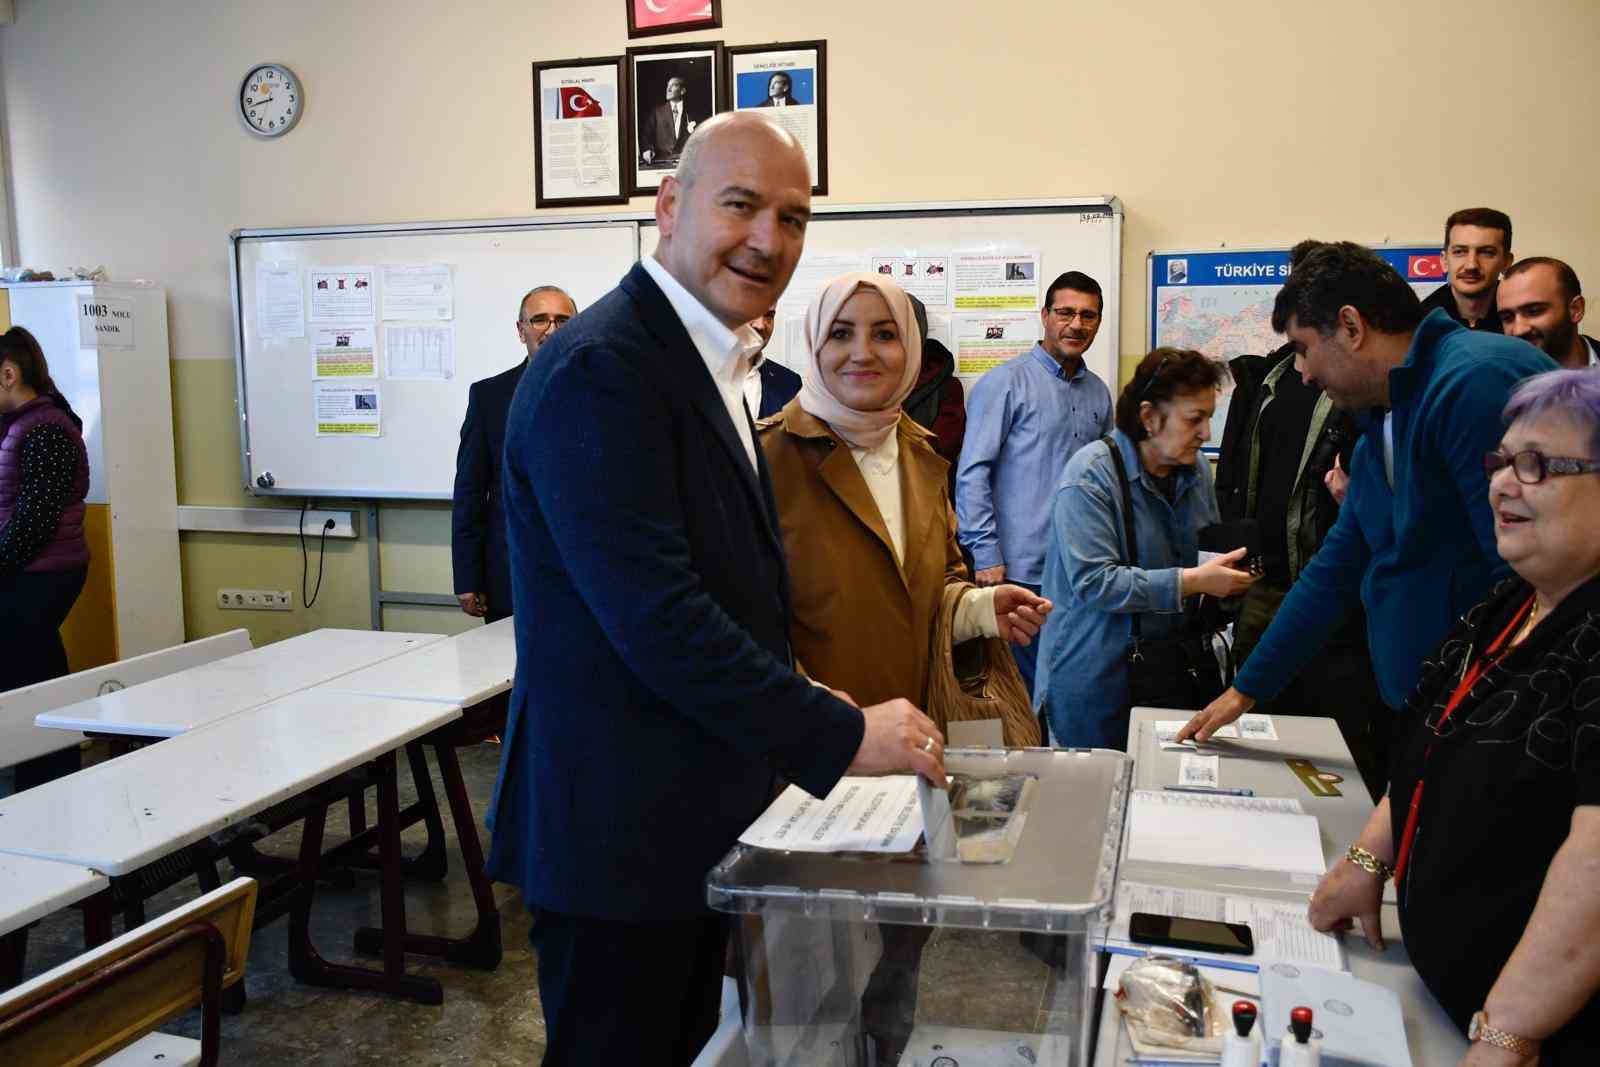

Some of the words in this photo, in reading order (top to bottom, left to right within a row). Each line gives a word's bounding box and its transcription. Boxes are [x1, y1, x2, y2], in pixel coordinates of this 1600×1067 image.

[1214, 263, 1275, 277] TÜRKİYE
[1278, 262, 1292, 276] Sİ
[83, 304, 108, 317] 1003
